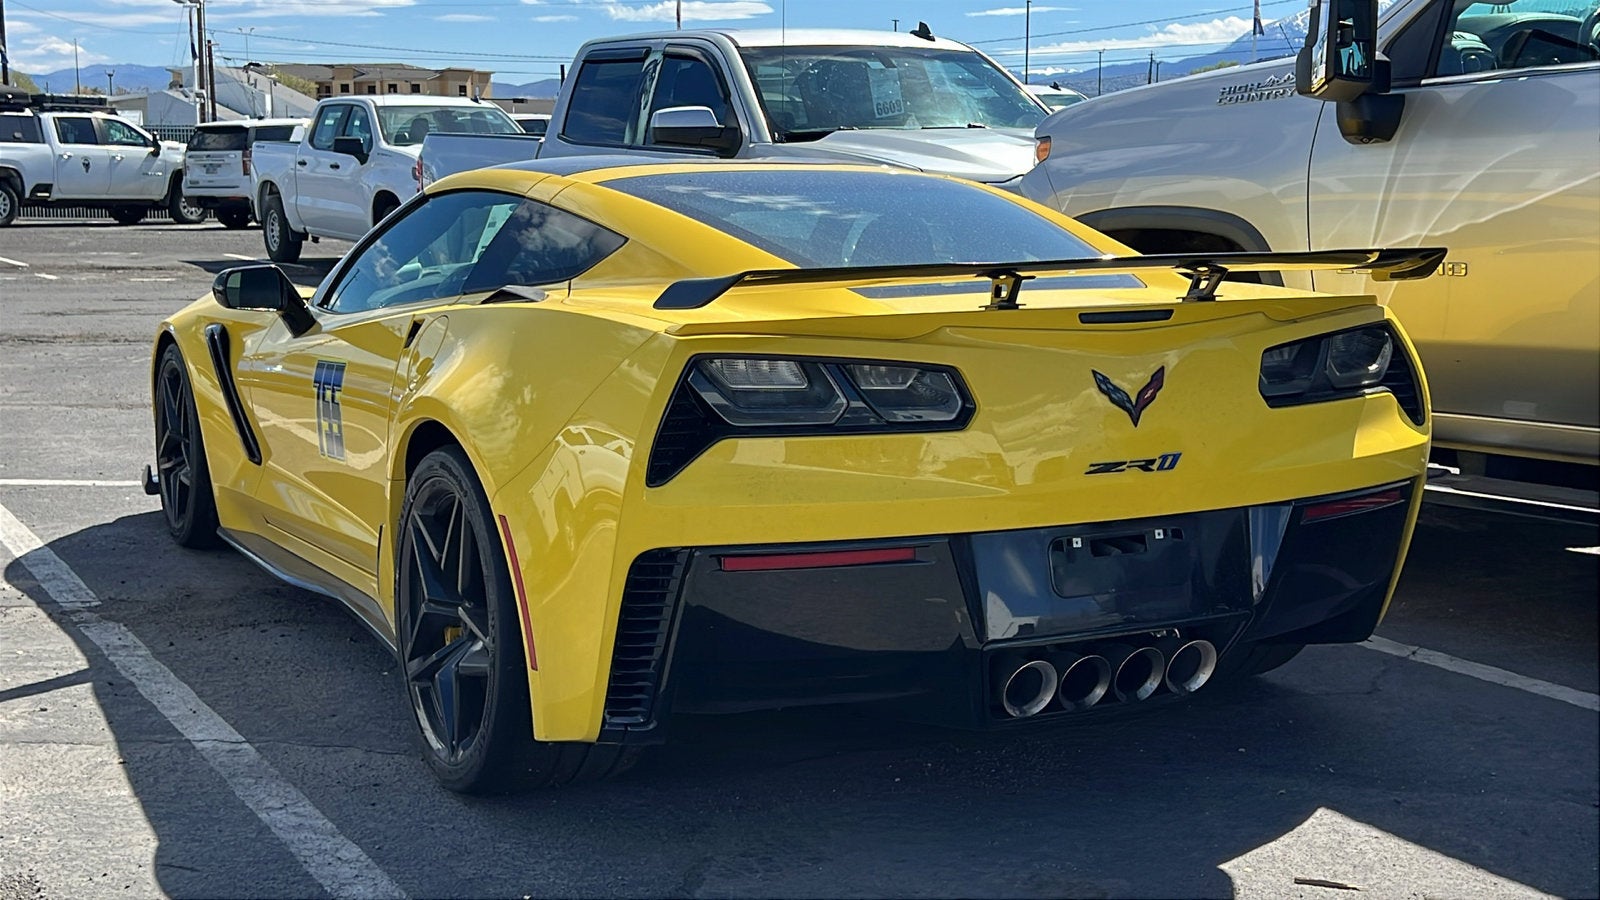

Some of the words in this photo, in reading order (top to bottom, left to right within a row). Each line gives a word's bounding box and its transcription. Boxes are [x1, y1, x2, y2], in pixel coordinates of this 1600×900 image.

[1216, 87, 1297, 106] COUNTRY
[1219, 82, 1264, 97] HIGH
[876, 100, 903, 116] 6609
[1084, 452, 1182, 475] ZR1
